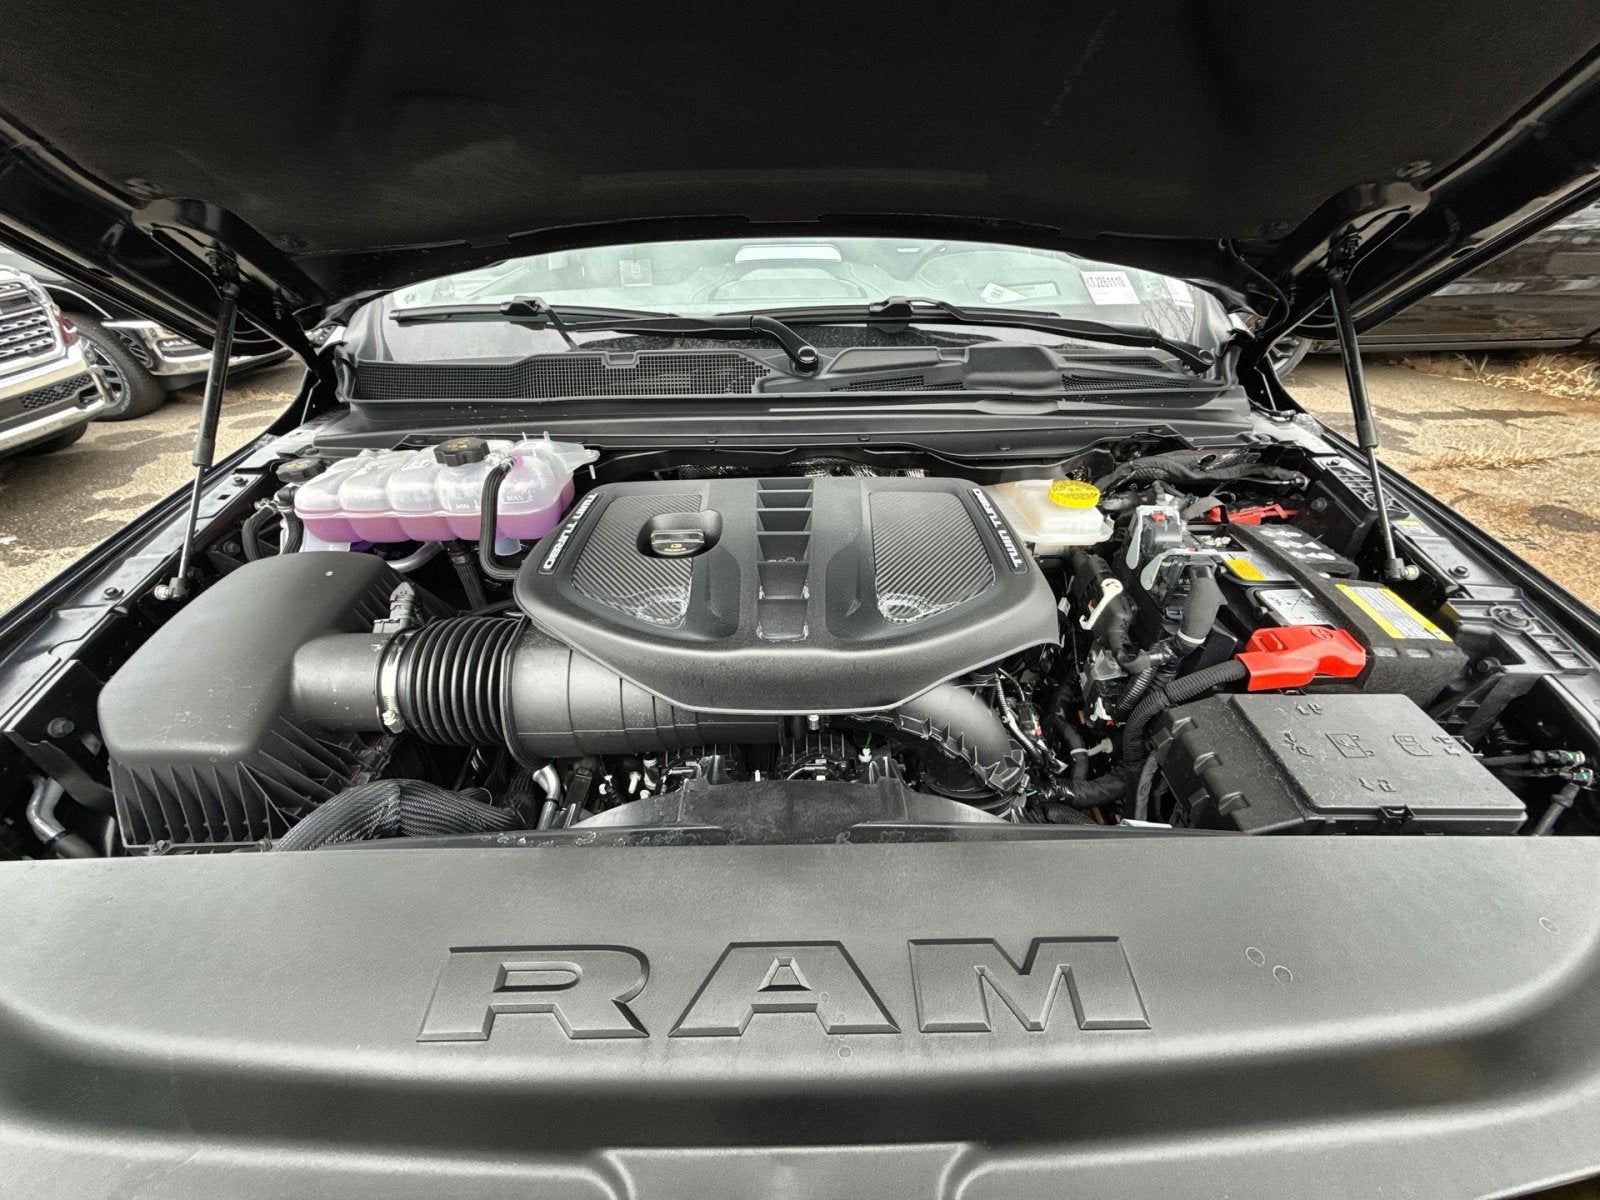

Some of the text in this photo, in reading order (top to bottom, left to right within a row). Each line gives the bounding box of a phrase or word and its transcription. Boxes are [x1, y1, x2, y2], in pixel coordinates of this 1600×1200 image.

[543, 493, 598, 569] TWIN TURBO
[972, 488, 1023, 568] TWIN TURBO
[416, 936, 1152, 1042] RAM
